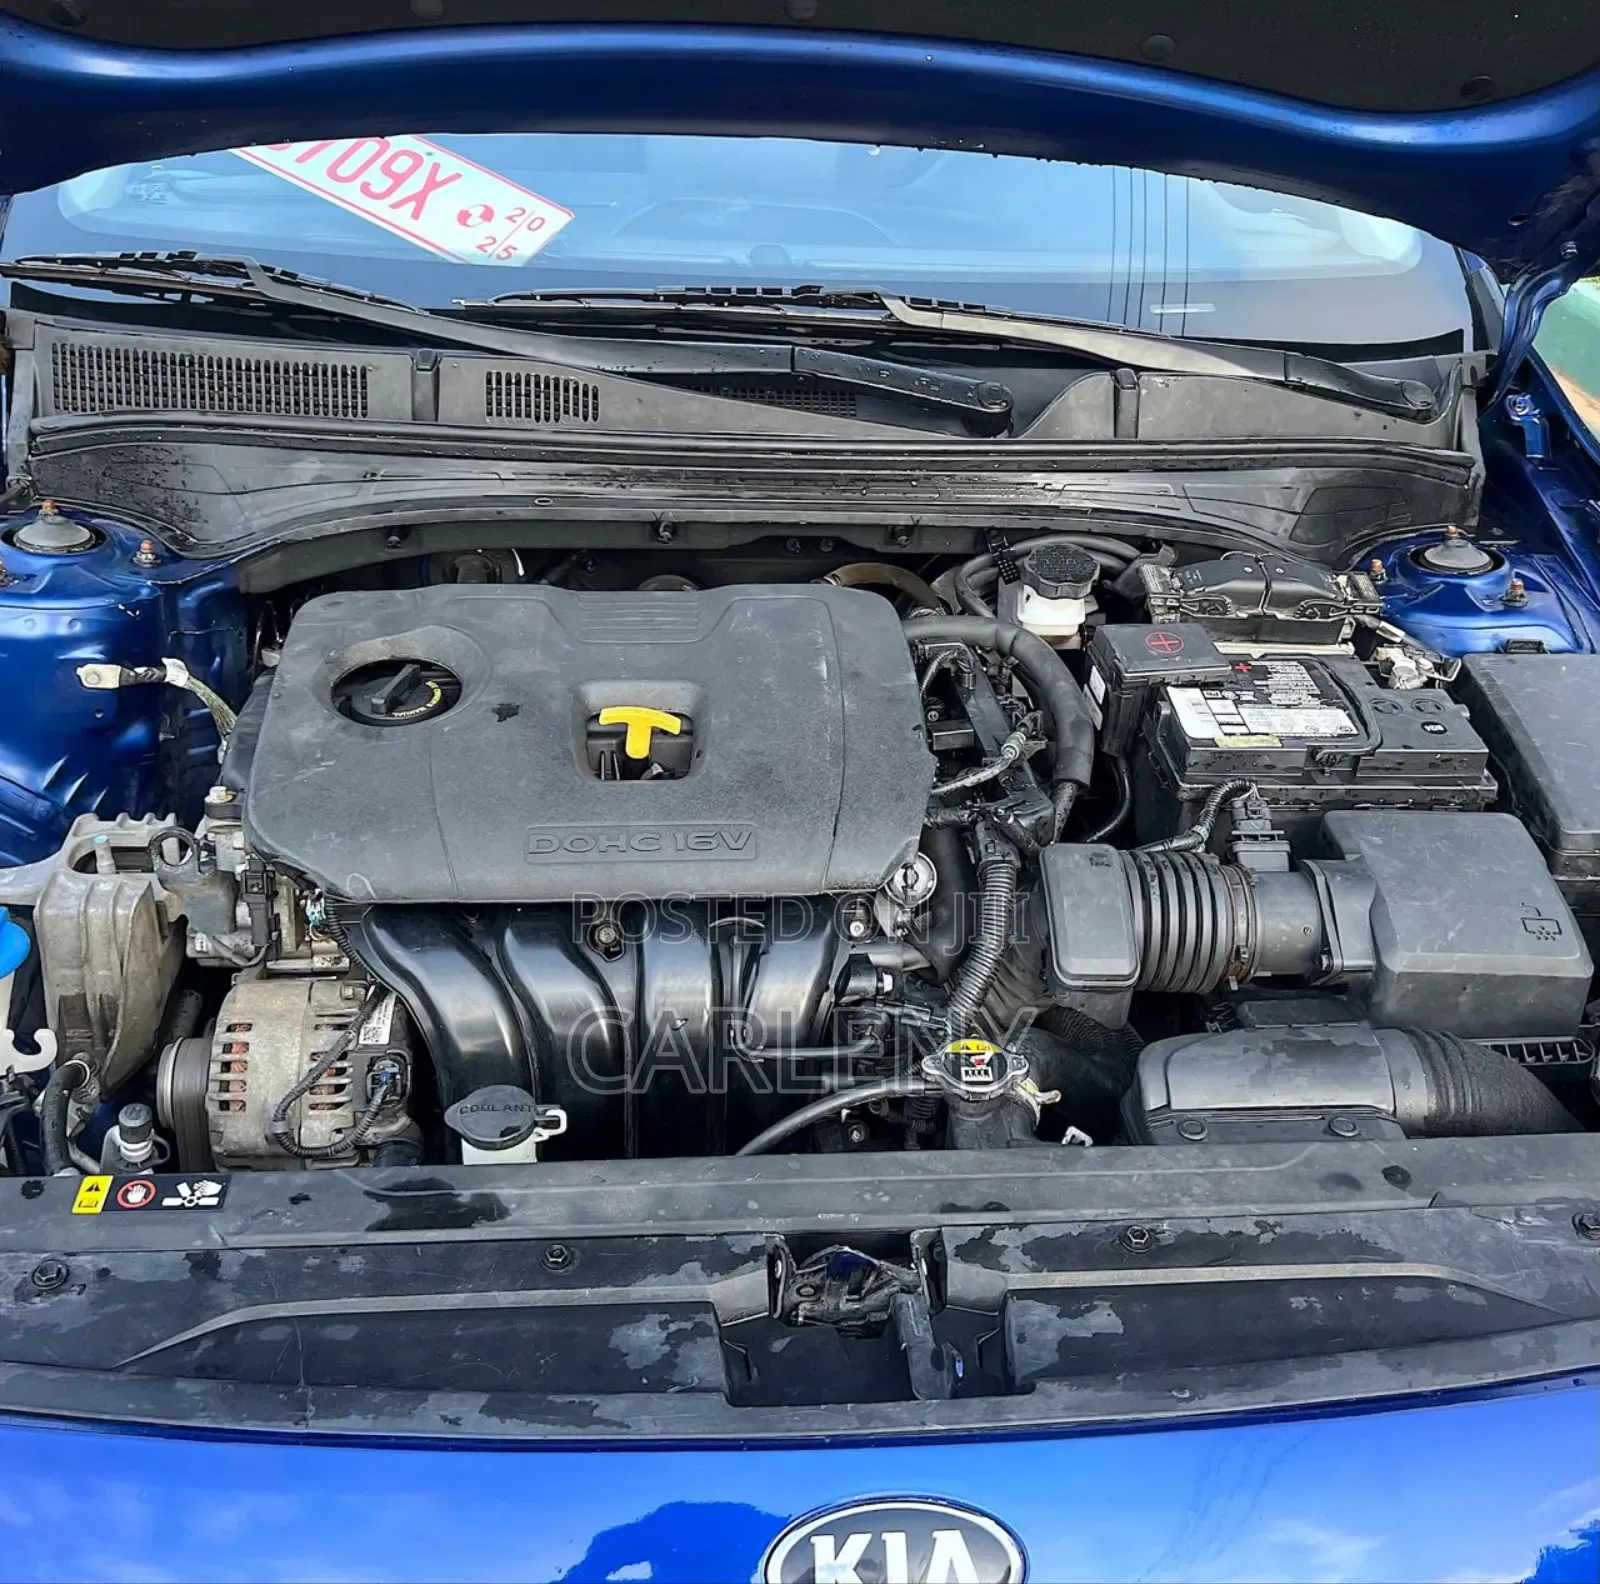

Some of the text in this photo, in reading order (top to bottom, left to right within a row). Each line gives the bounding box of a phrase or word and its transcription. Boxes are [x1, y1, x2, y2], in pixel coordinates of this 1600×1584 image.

[528, 830, 752, 854] DOHC 16V
[459, 1103, 533, 1115] COOLANT
[809, 1529, 981, 1584] KIA
